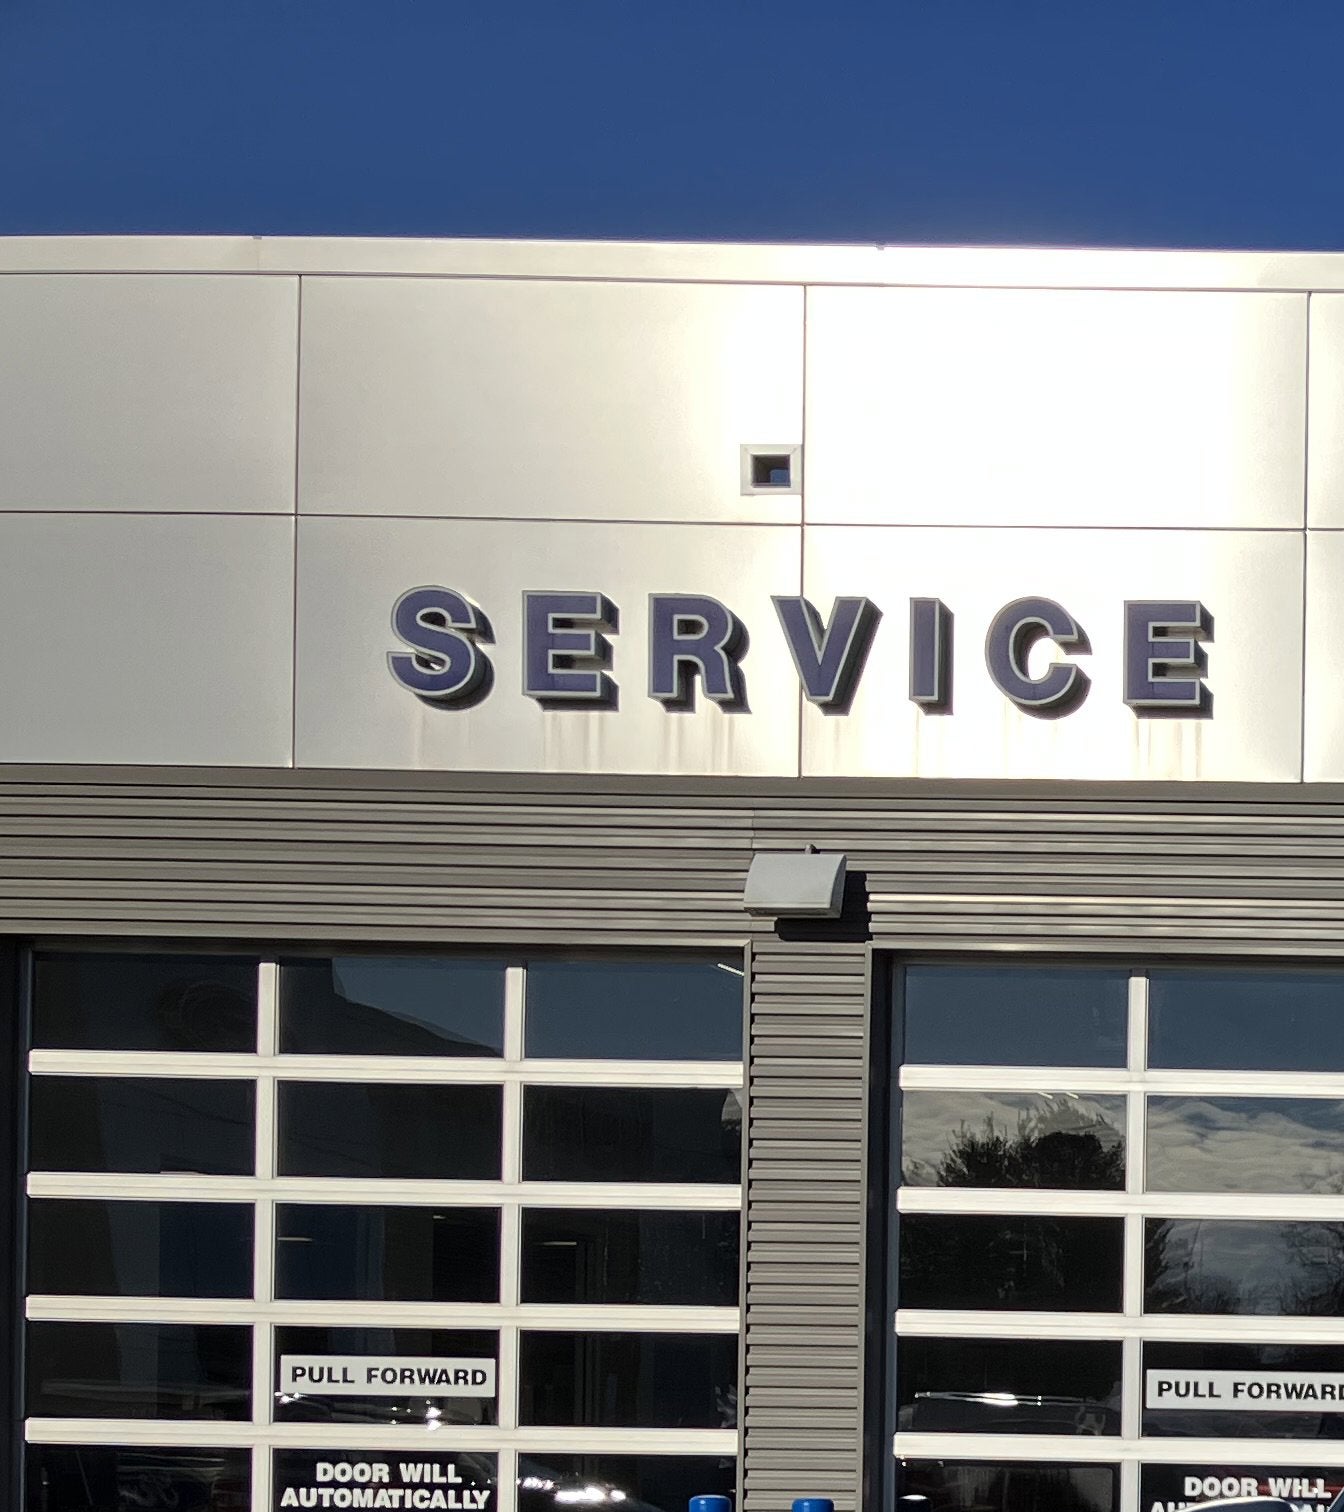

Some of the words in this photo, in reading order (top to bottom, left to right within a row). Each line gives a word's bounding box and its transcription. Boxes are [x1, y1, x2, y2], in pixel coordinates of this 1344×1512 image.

[386, 585, 1214, 720] SERVICE
[290, 1366, 356, 1385] PULL
[366, 1366, 488, 1387] FORWARD
[1157, 1380, 1222, 1399] PULL
[315, 1462, 390, 1484] DOOR
[399, 1462, 462, 1484] WILL
[280, 1486, 490, 1510] AUTOMATICALLY
[1184, 1476, 1259, 1497] DOOR
[1268, 1477, 1332, 1499] WILL
